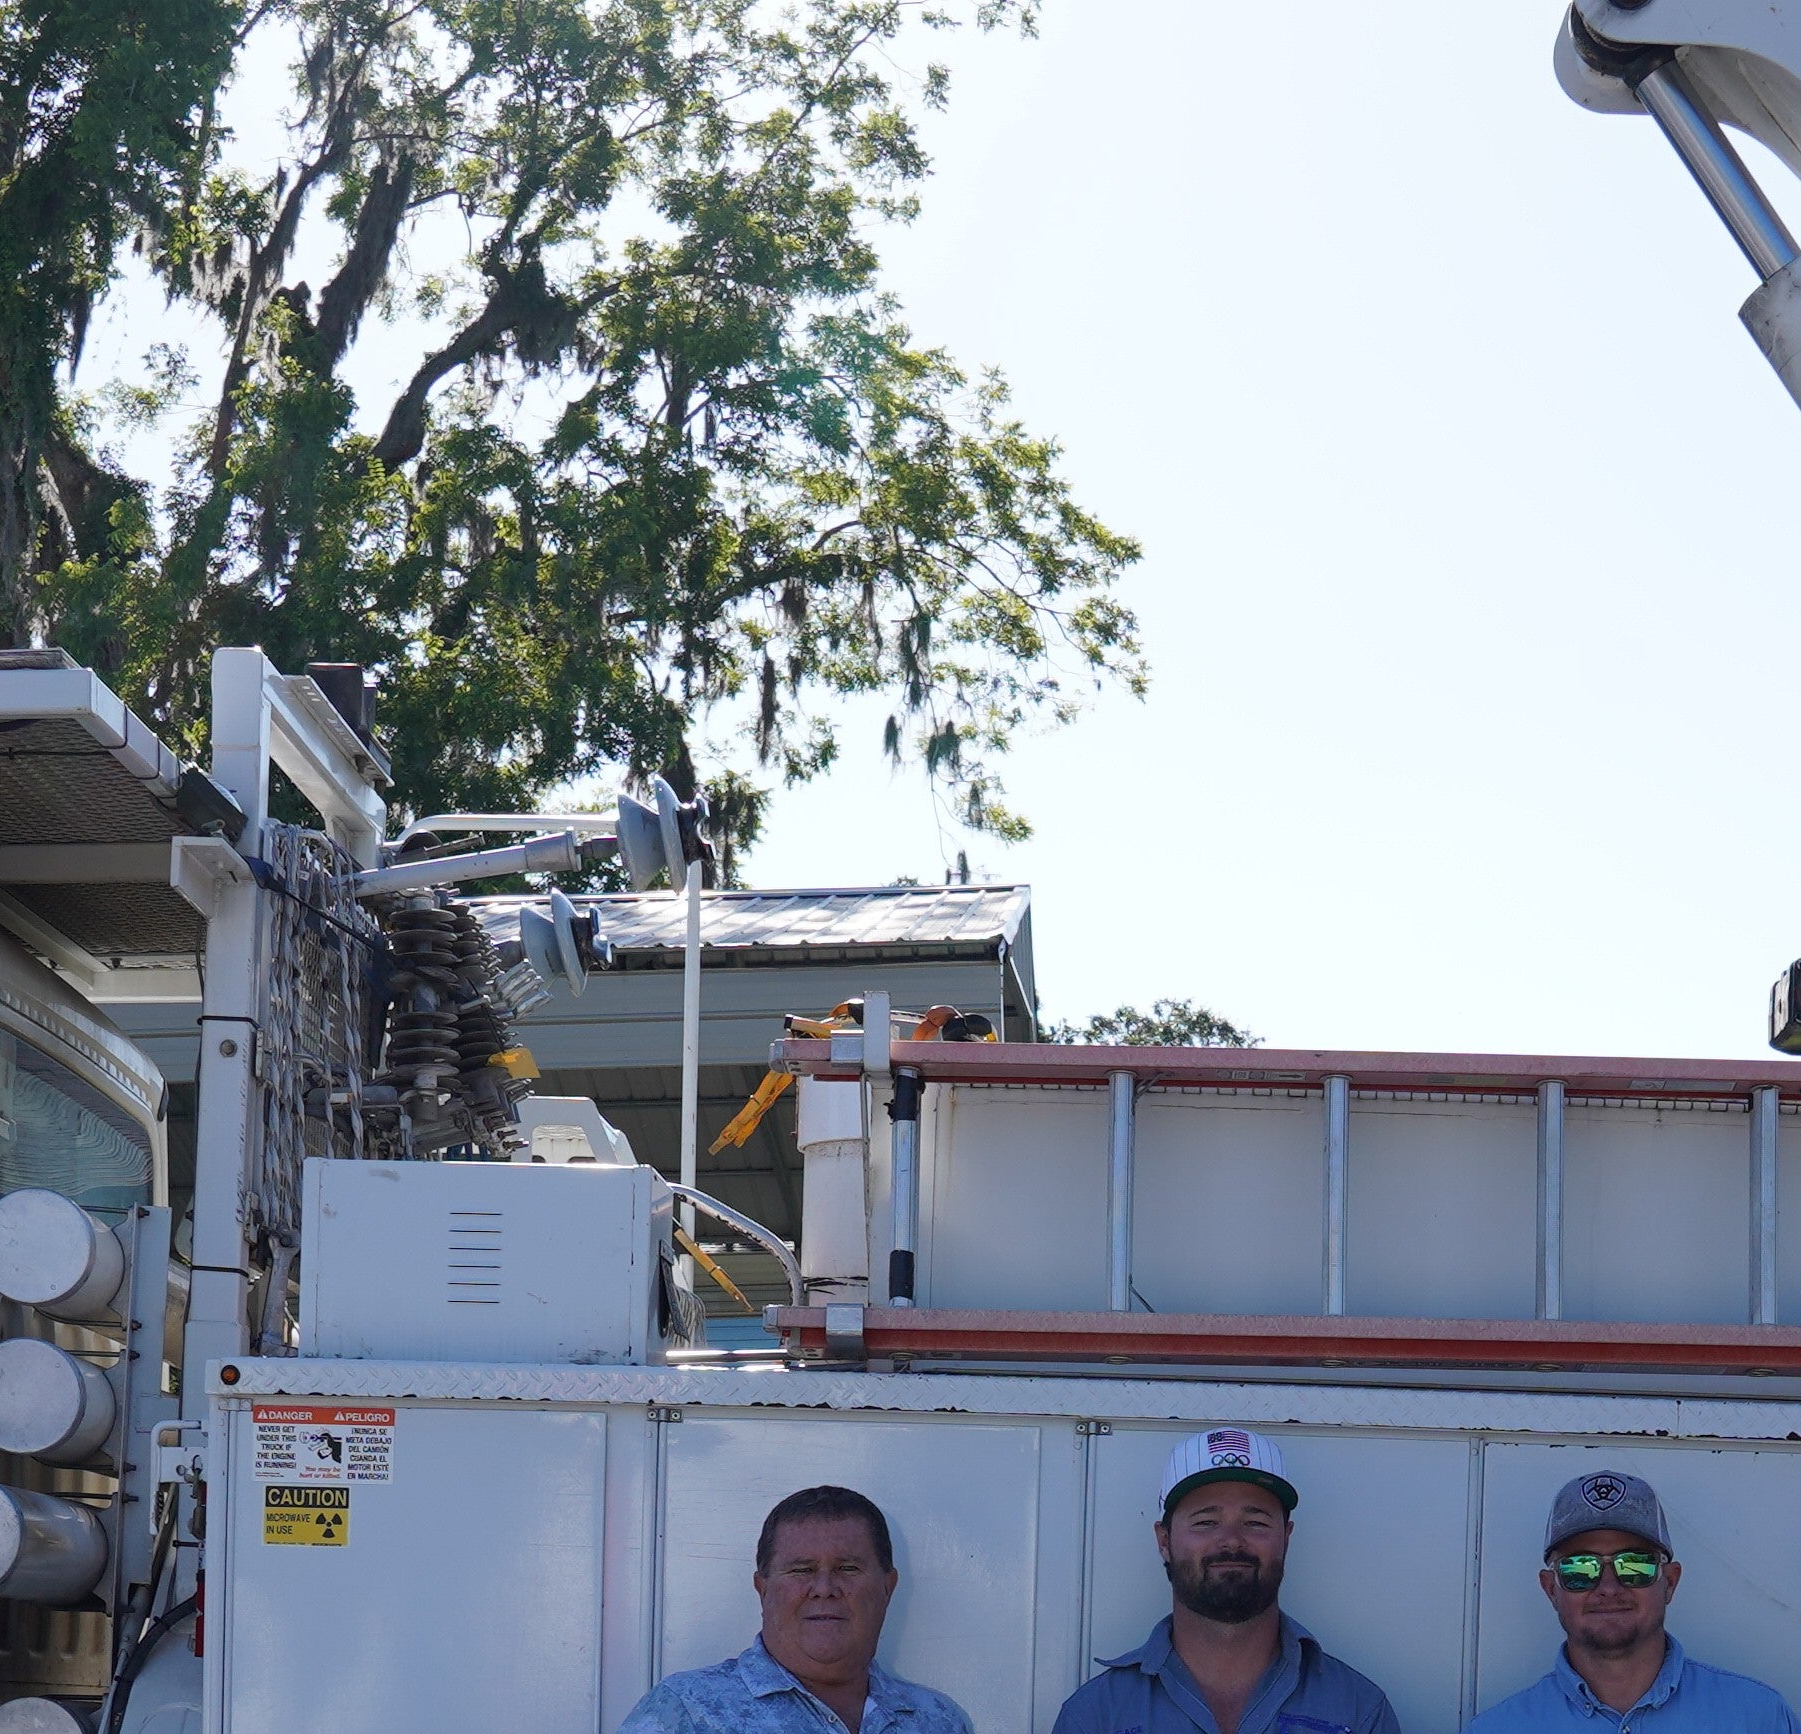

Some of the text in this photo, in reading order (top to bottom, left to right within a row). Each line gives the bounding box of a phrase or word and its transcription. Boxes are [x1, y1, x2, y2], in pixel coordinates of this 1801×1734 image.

[268, 1410, 390, 1423] DANGER PELIGRO
[258, 1425, 280, 1433] NEVER
[268, 1488, 347, 1507] CAUTION
[266, 1513, 311, 1523] MICROWAVE
[266, 1526, 293, 1534] IN USE
